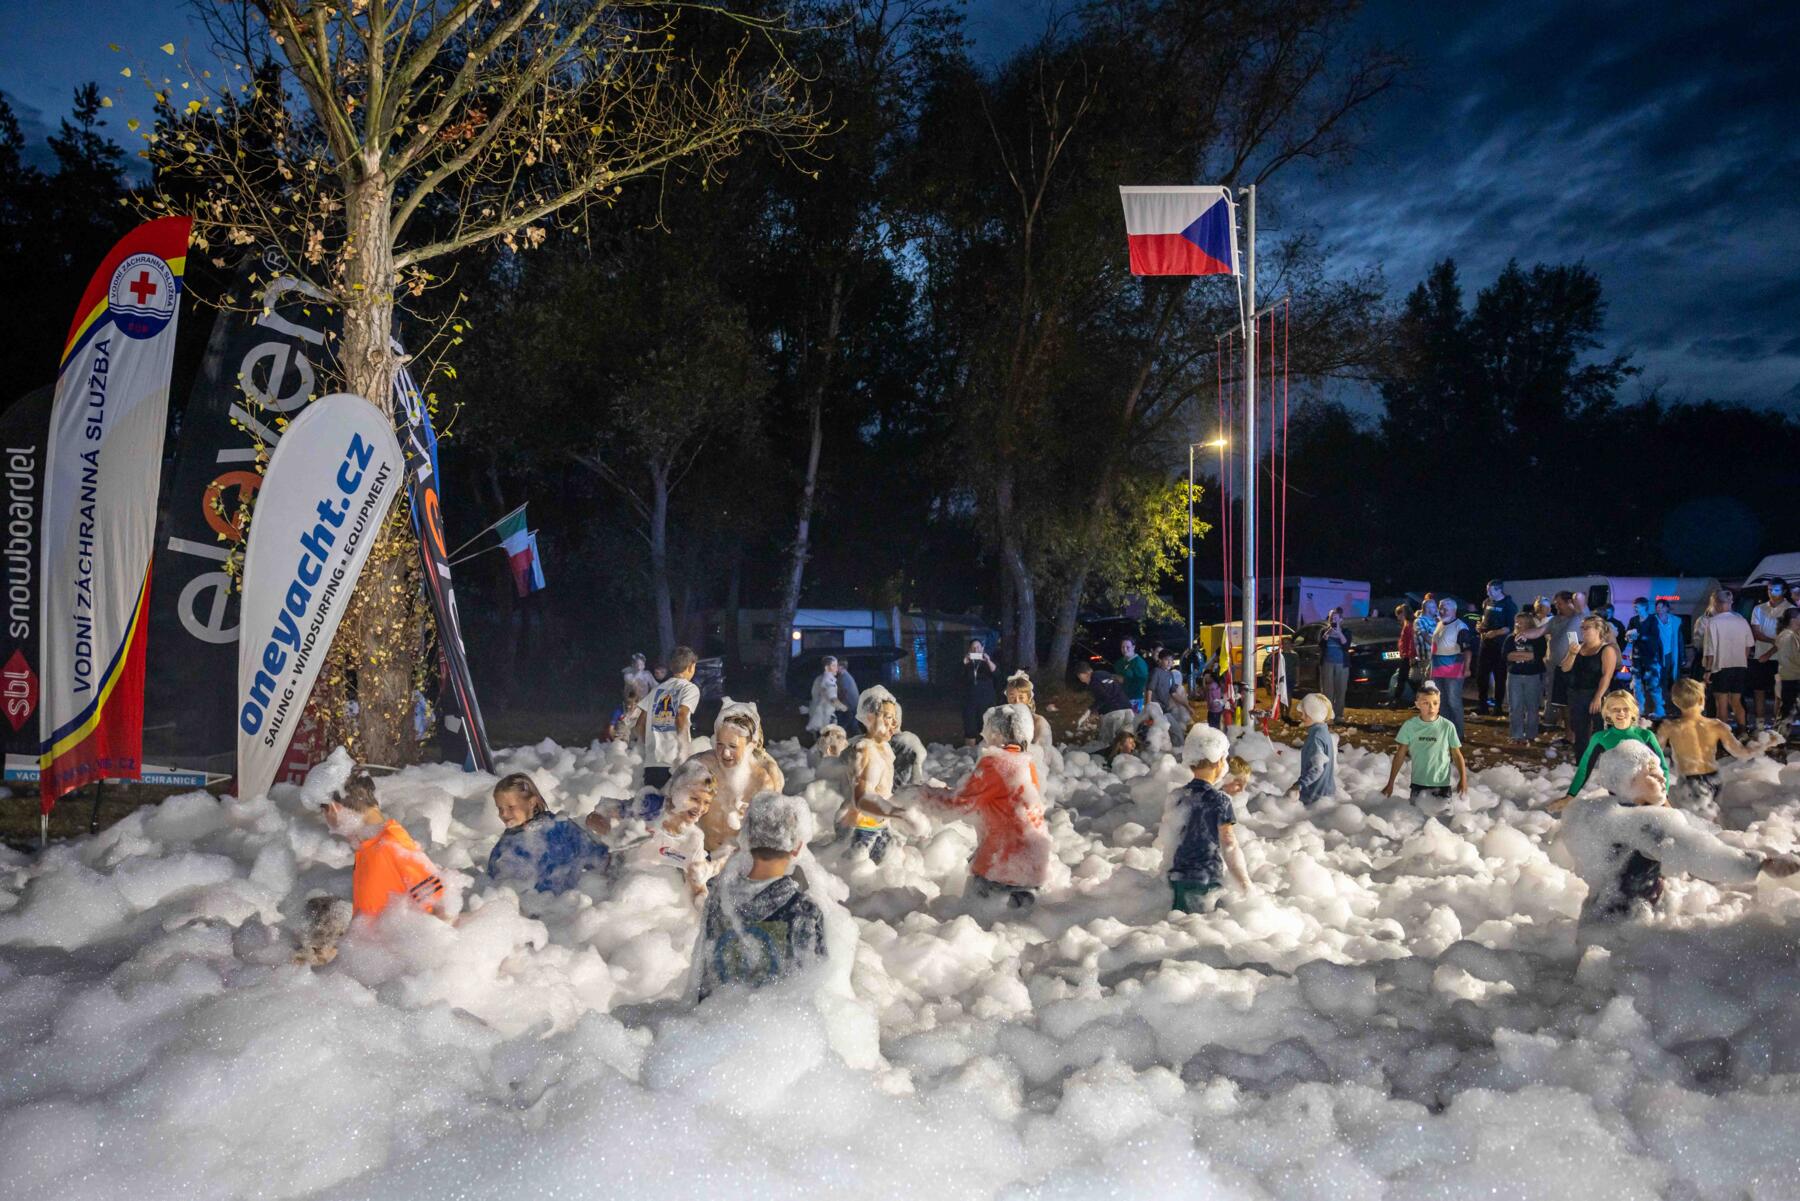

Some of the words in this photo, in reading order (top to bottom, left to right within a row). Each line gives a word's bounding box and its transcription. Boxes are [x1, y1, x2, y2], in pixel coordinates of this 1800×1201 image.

[86, 338, 111, 441] SLUŽBA
[5, 445, 36, 640] snowboardel
[75, 449, 100, 610] ZÁCHRANNÁ
[240, 432, 375, 736] oneyacht.cz
[264, 687, 295, 748] SAILING
[292, 566, 345, 675] WINDSURFING
[345, 461, 392, 556] EQUIPMENT
[73, 614, 92, 693] VODNÍ
